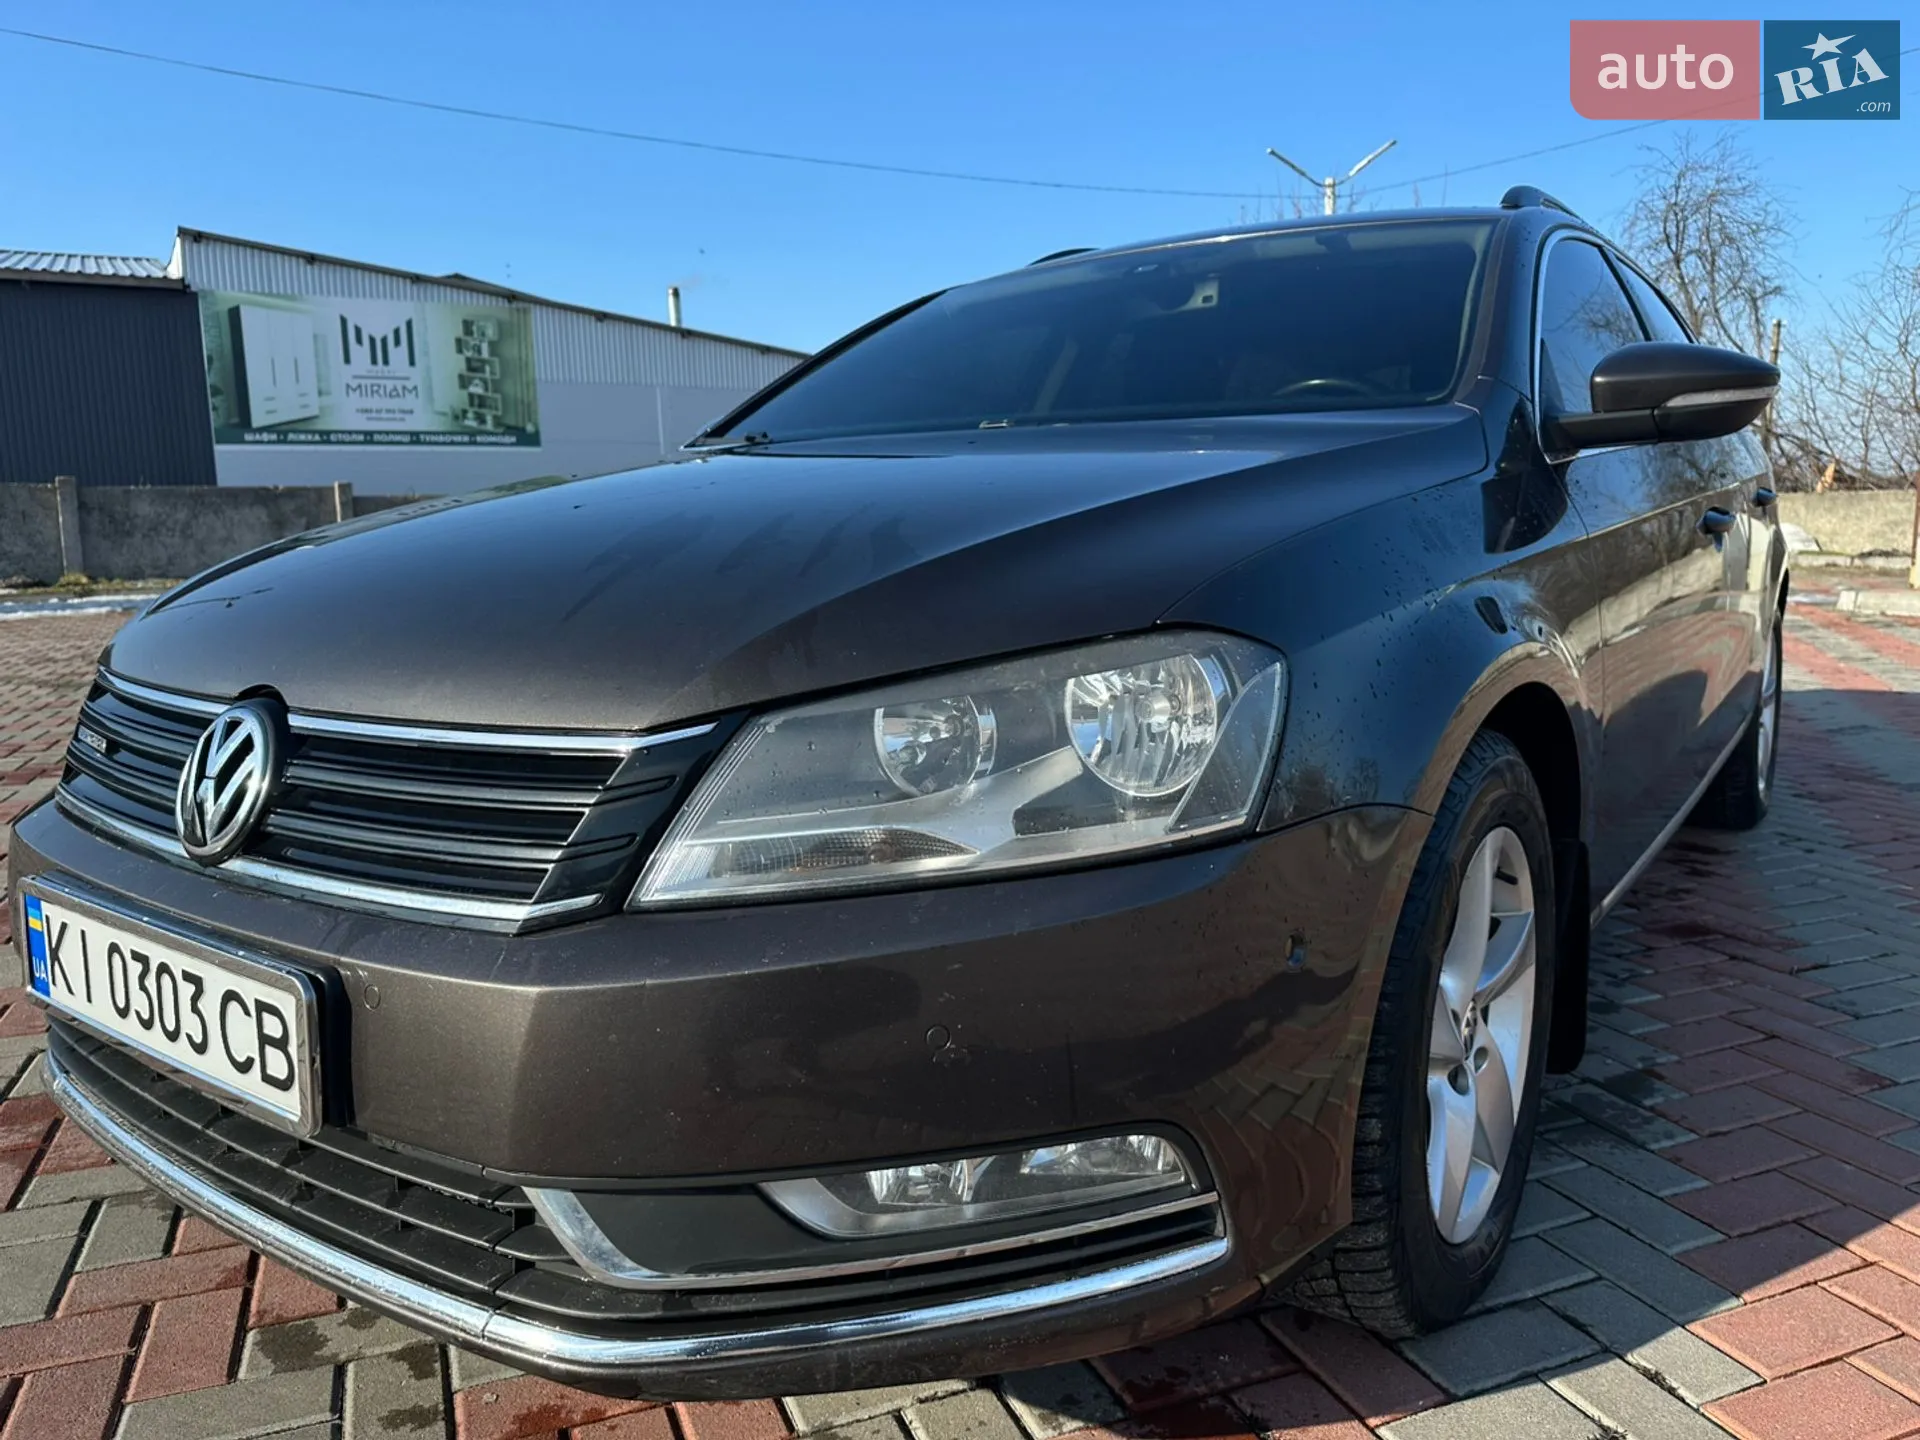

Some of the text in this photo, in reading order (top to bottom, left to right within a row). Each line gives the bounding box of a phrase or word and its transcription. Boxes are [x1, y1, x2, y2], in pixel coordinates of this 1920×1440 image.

[345, 382, 419, 399] MIRIAM
[32, 956, 48, 982] UA
[45, 913, 296, 1092] KI 0303 CB
